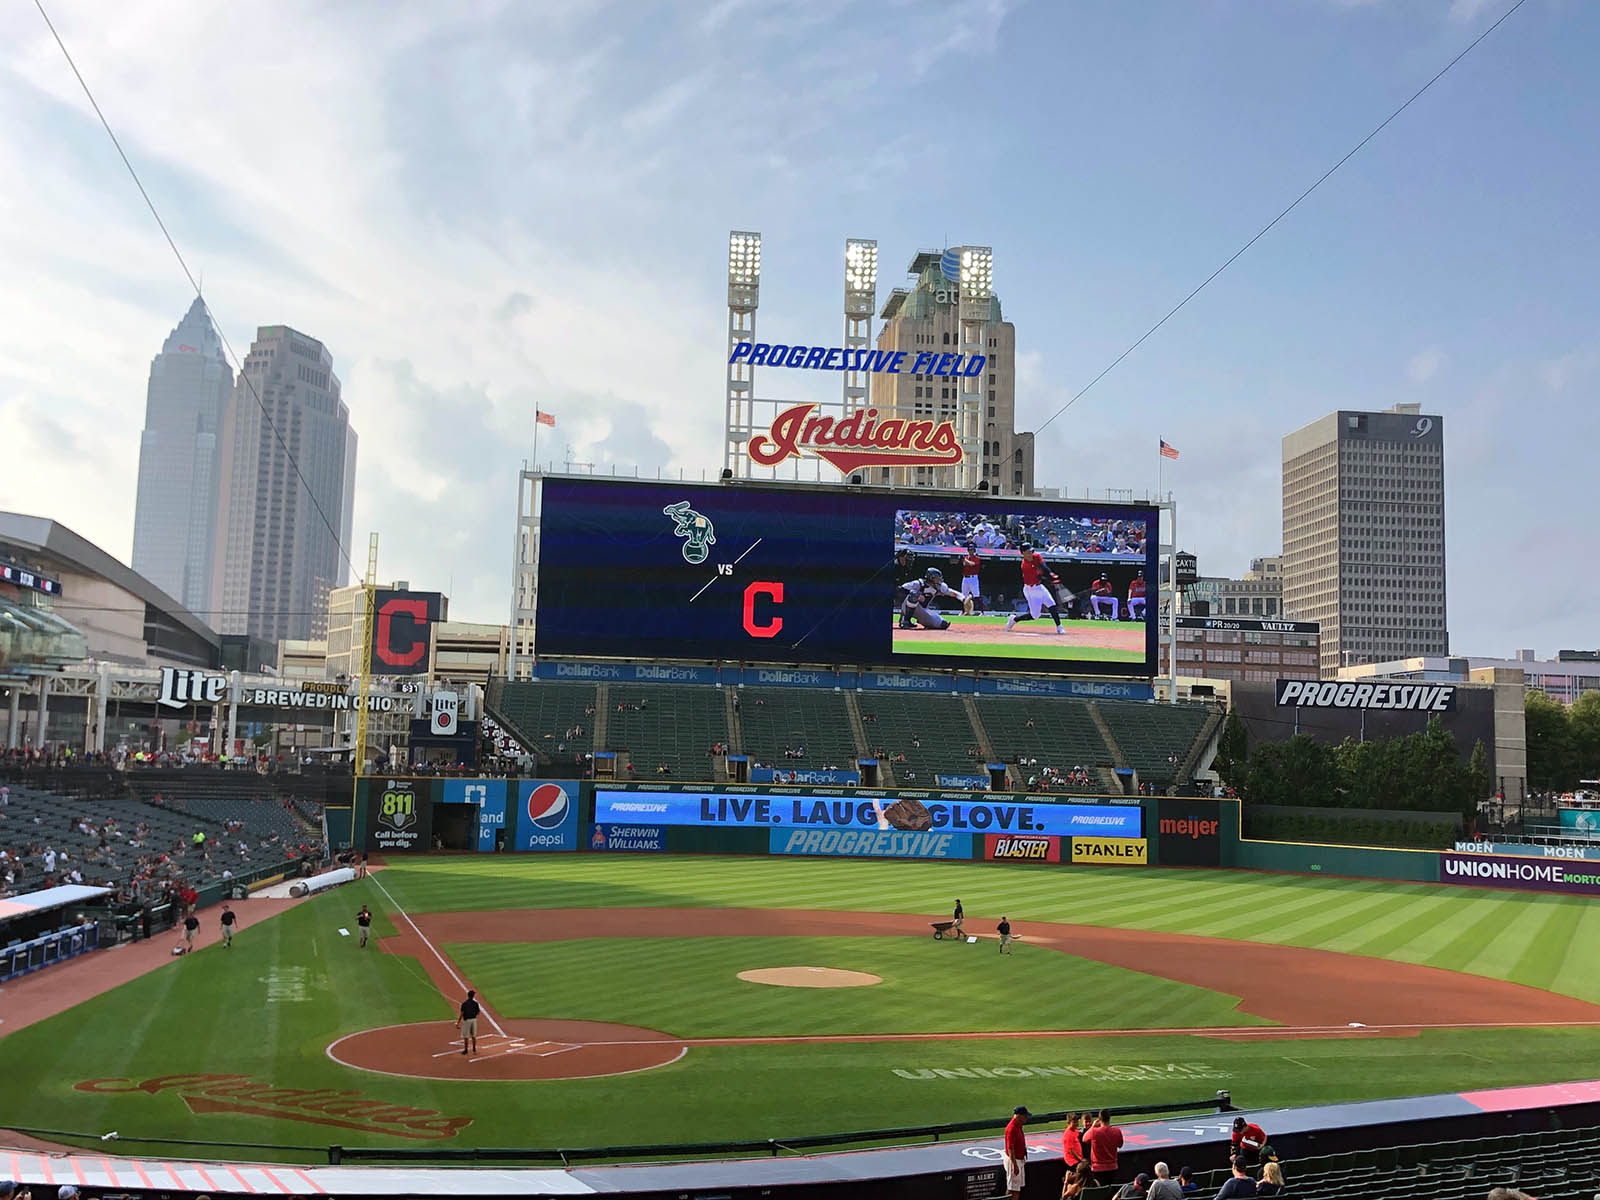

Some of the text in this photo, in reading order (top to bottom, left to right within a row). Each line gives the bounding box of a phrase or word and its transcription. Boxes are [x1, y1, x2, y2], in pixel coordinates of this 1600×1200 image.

[729, 342, 986, 377] PROGRESSIVE FIELD
[1416, 417, 1432, 439] 9
[748, 402, 963, 475] Indians
[1176, 559, 1195, 567] CAXTO
[742, 581, 784, 638] C
[376, 599, 428, 666] C
[1212, 620, 1223, 629] PR
[1261, 622, 1295, 631] VAULTZ
[157, 666, 227, 709] Lite
[302, 682, 349, 694] PROUDLY
[1279, 681, 1453, 711] PROGRESSIVE
[254, 689, 392, 711] BREWED IN OHIO
[435, 698, 457, 712] Lite
[383, 793, 412, 815] 811
[610, 802, 668, 813] PROGRESSIVE
[700, 798, 1045, 831] LIVE. LAUG GLOVE.
[1071, 815, 1126, 826] PROGRESSIVE
[375, 831, 418, 840] Call before
[610, 826, 659, 838] SHERWIN
[1160, 816, 1218, 839] meijer
[380, 839, 411, 848] you dig.
[529, 833, 564, 847] pepsi
[785, 830, 953, 857] PROGRESSIVE
[994, 839, 1049, 858] BLASTER
[1455, 841, 1493, 853] MOEN
[1074, 843, 1145, 858] STANLEY
[1544, 847, 1585, 858] MOEN
[1445, 860, 1564, 882] UNIONHOME
